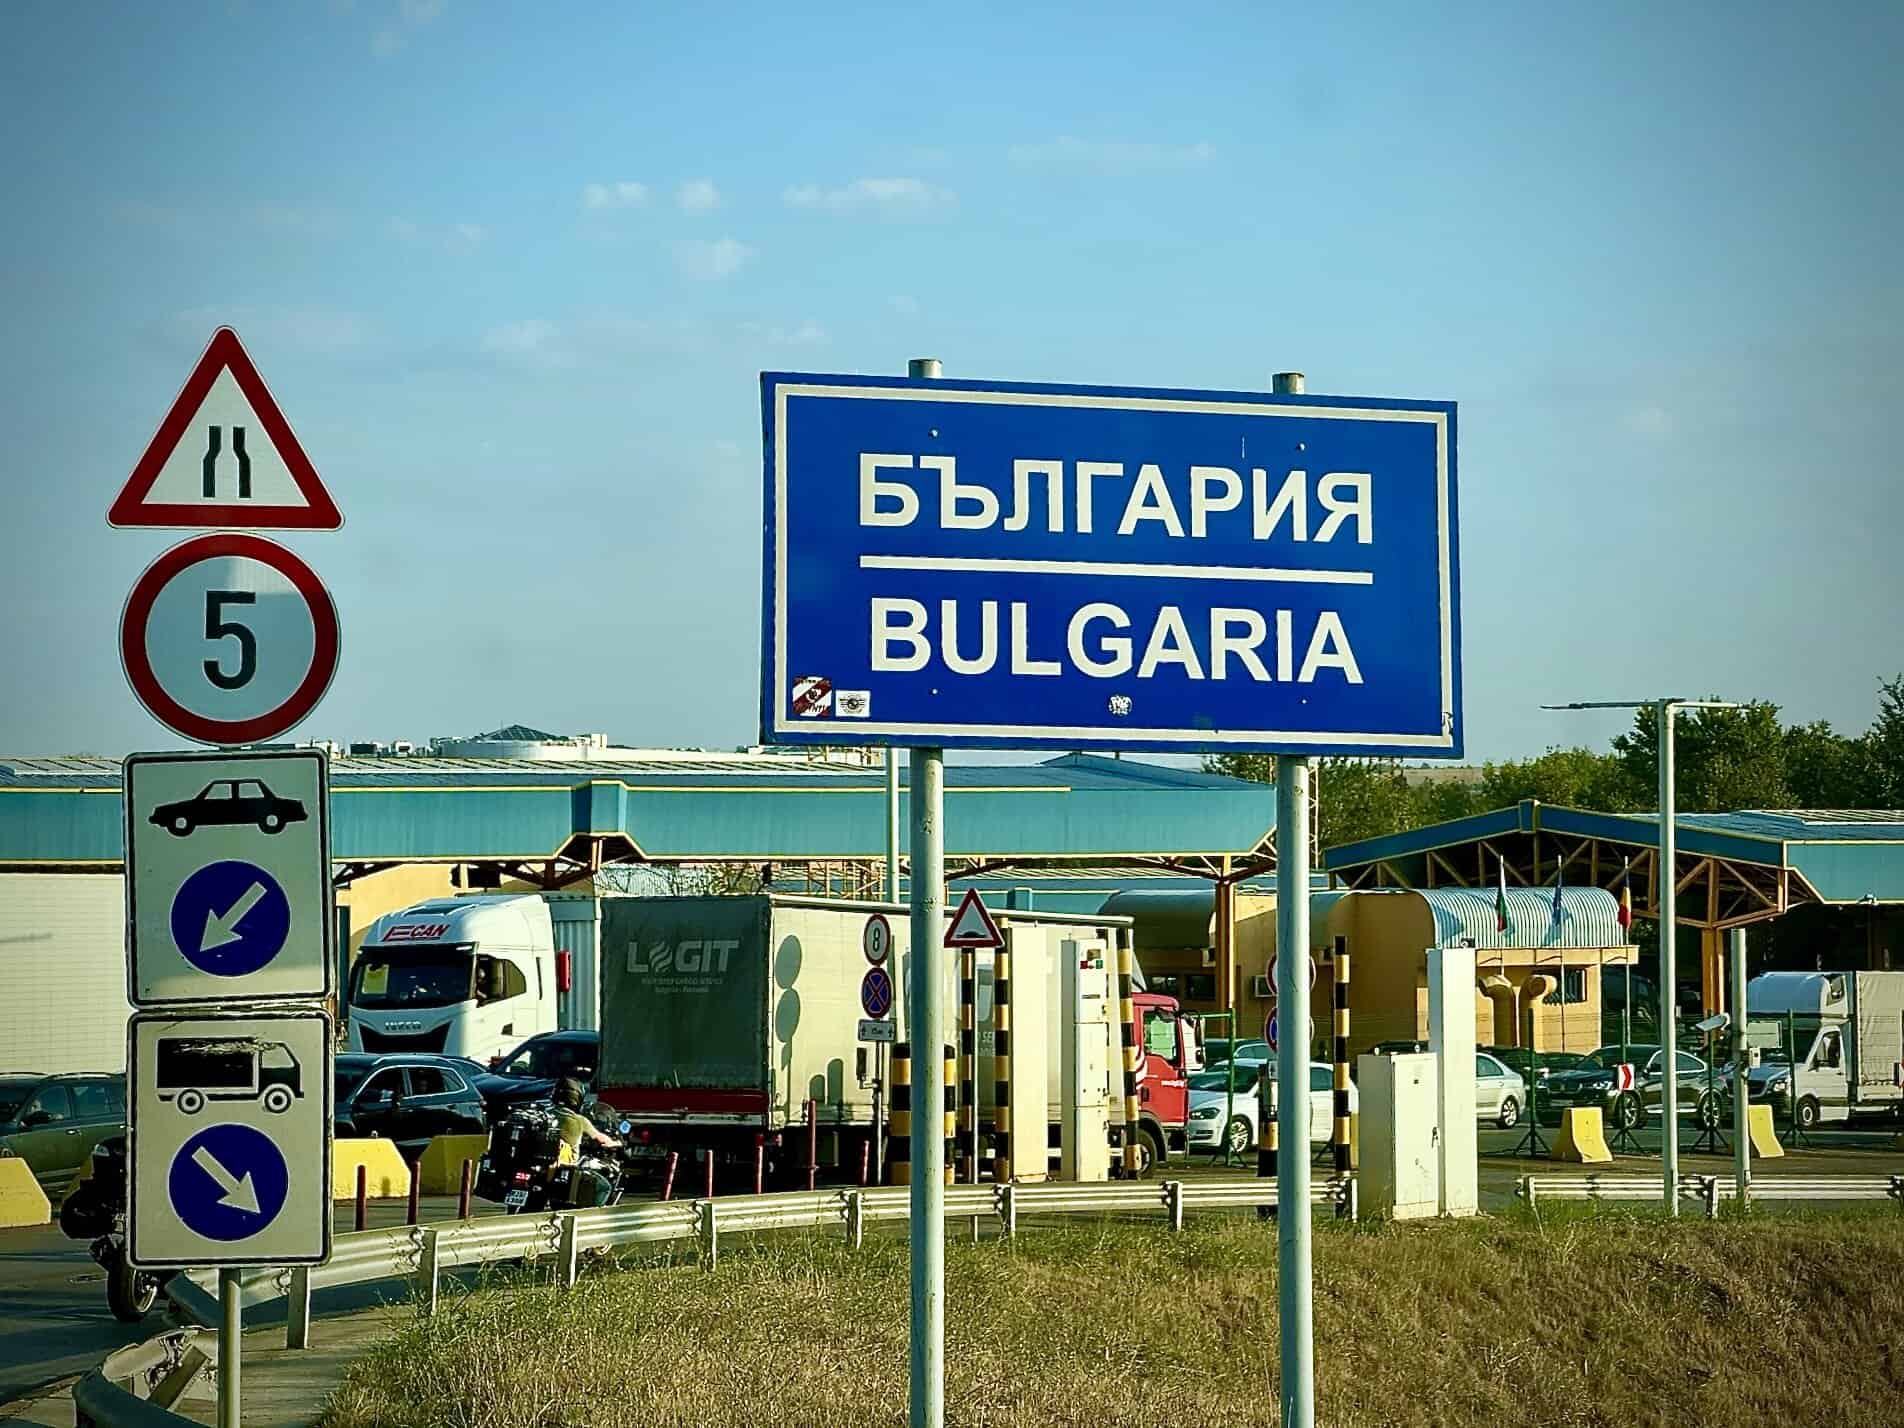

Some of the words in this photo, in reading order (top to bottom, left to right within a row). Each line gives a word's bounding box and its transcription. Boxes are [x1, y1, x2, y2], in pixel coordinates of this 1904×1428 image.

[859, 452, 1373, 545] БЪЛГАРИЯ
[203, 590, 257, 691] 5
[871, 597, 1364, 685] BULGARIA
[382, 924, 451, 942] ECAN
[872, 927, 881, 952] 8
